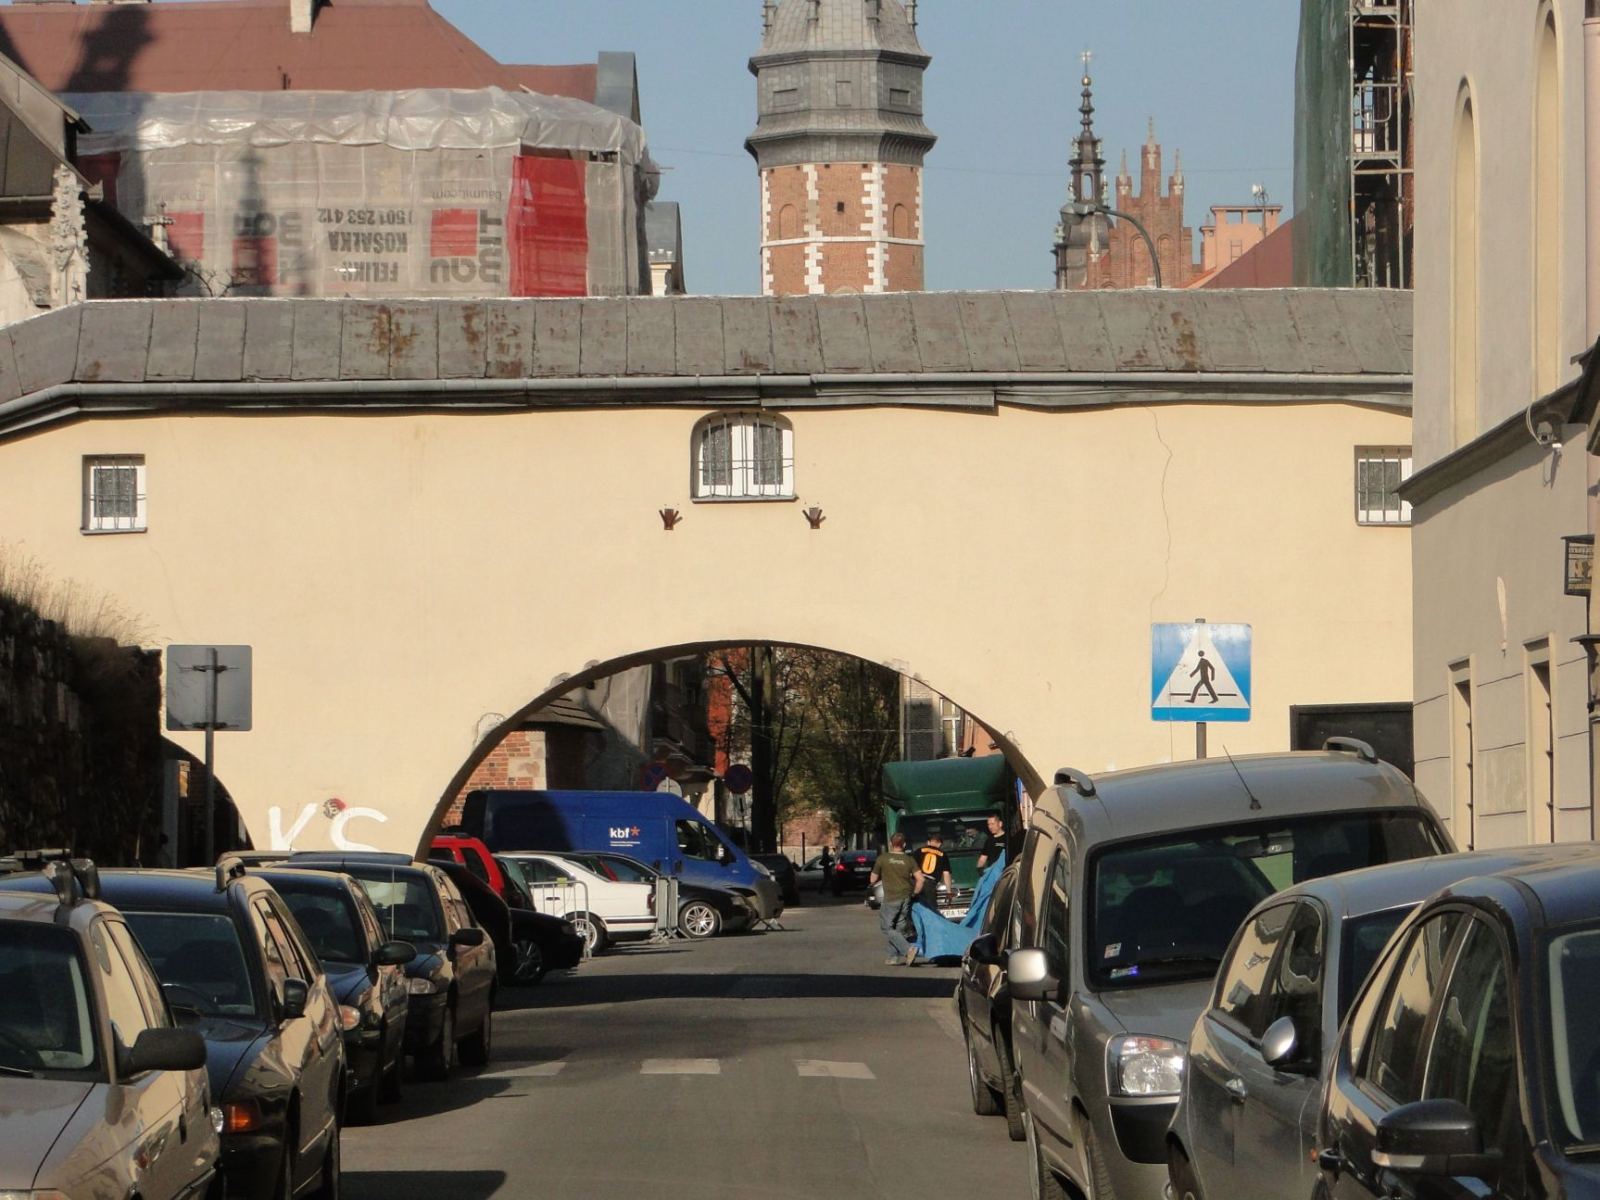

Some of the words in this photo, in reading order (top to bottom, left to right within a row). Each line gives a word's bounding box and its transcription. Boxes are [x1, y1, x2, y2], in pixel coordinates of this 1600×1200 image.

[316, 208, 344, 224] 412
[347, 209, 375, 225] 253
[609, 827, 630, 839] kbf
